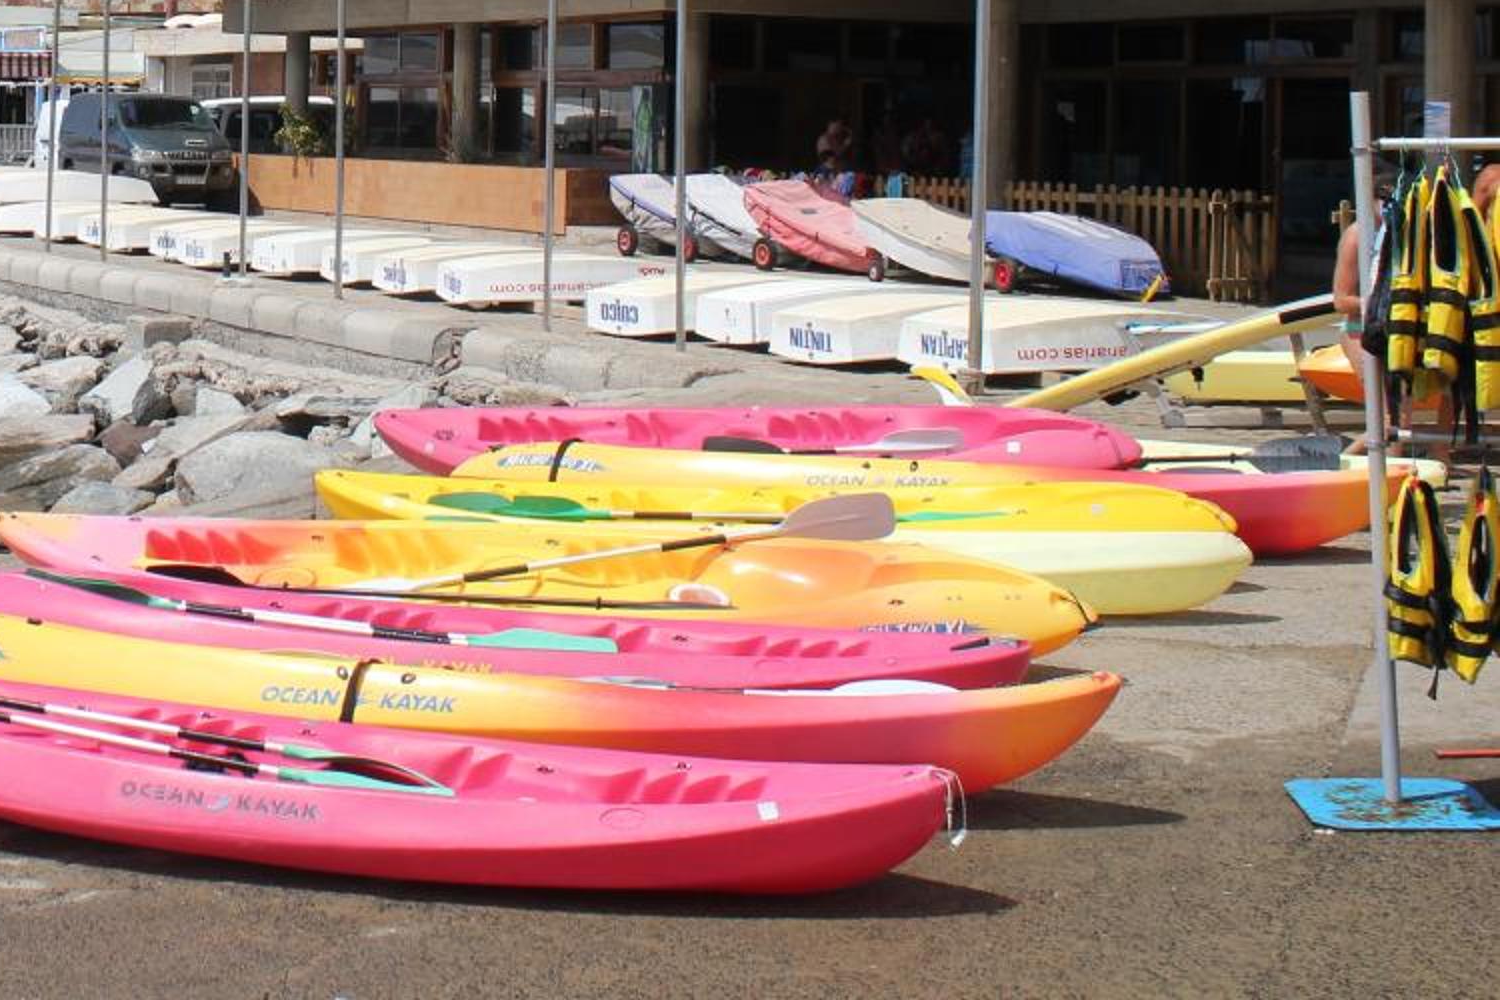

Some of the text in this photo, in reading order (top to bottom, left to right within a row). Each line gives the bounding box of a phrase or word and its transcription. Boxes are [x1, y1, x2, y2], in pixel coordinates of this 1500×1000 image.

[789, 327, 833, 353] TINTIN
[805, 474, 951, 488] OCEAN KAYAK
[261, 685, 458, 713] OCEAN KAYAK
[120, 780, 321, 820] OCEAN KAYAK
